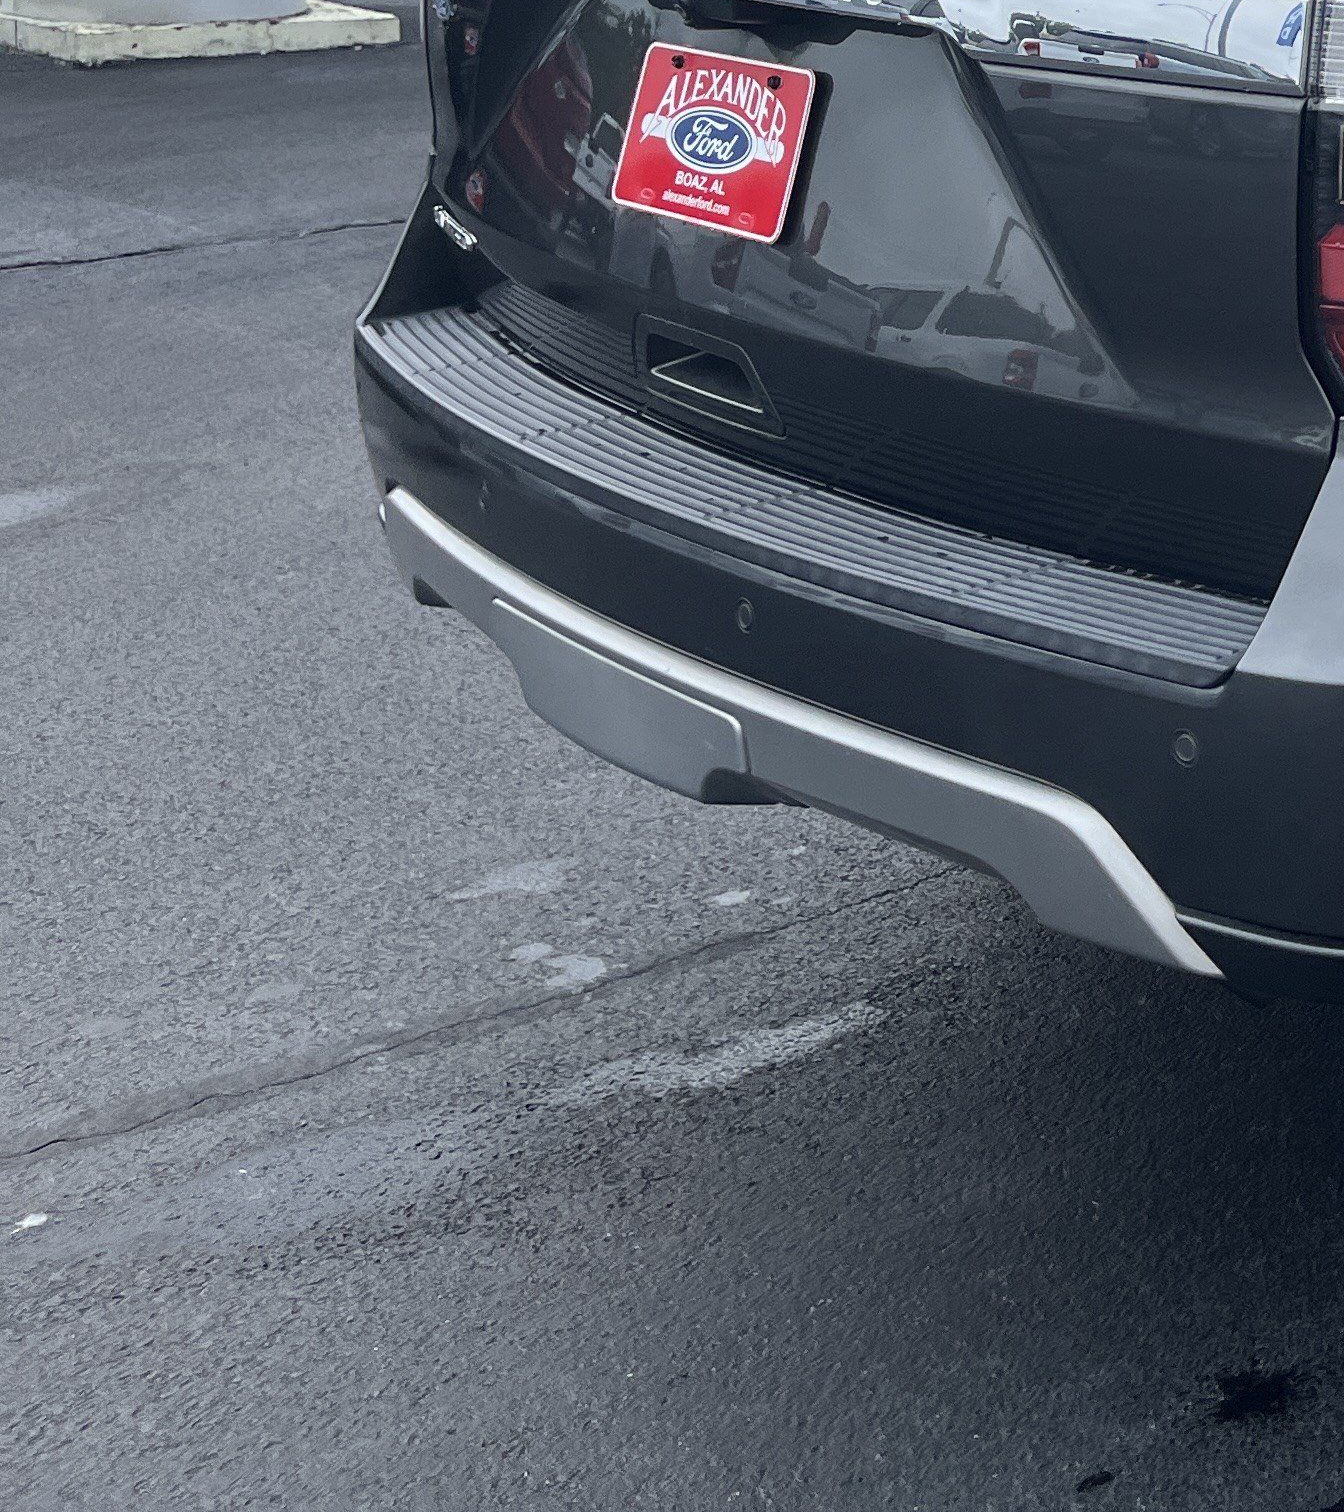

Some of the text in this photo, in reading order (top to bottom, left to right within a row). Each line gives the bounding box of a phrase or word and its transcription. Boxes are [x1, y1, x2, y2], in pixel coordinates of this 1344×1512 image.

[639, 68, 788, 168] ALEXANDER
[683, 116, 740, 162] Ford
[707, 181, 726, 197] AL
